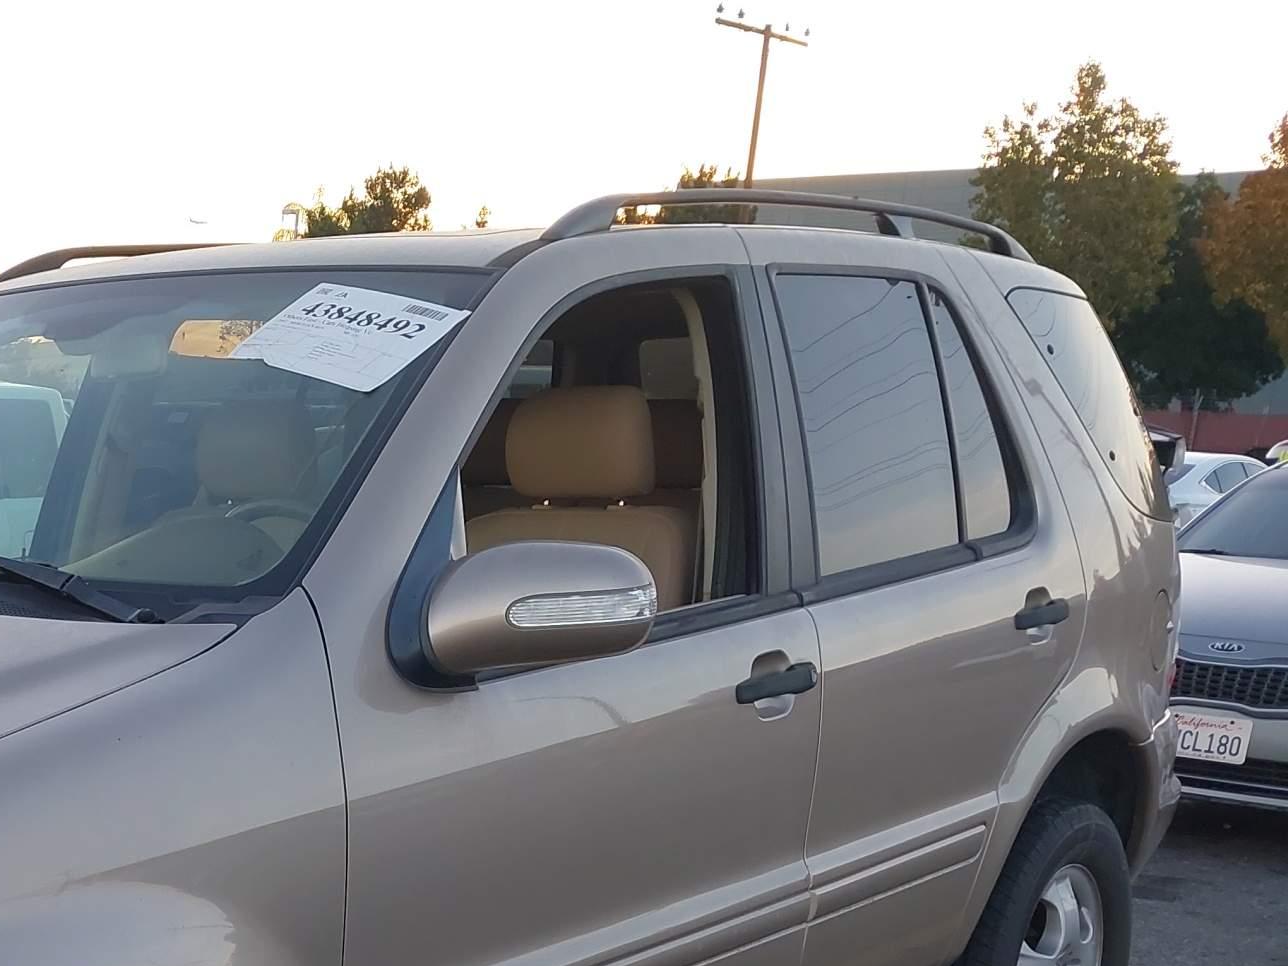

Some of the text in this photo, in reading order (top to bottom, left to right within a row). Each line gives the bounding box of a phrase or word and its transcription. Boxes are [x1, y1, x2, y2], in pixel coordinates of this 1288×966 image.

[301, 302, 426, 339] 43848492
[1211, 641, 1241, 652] KIA
[1176, 714, 1234, 731] California
[1177, 730, 1242, 757] CL180
